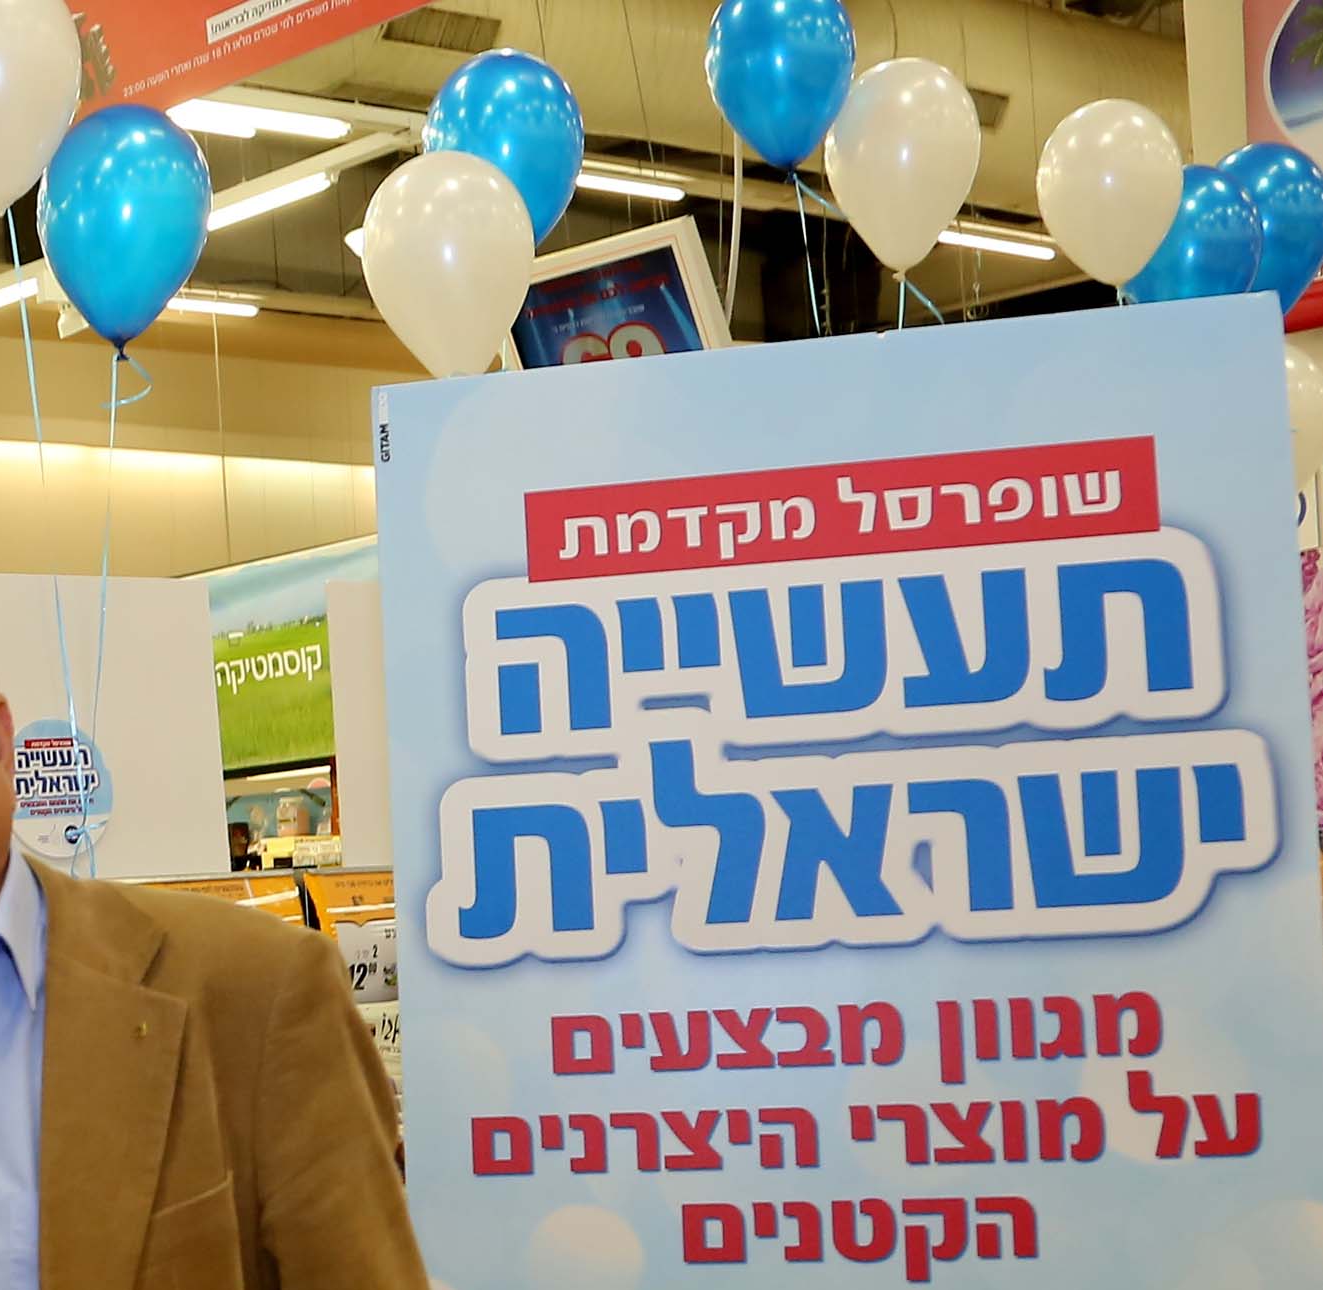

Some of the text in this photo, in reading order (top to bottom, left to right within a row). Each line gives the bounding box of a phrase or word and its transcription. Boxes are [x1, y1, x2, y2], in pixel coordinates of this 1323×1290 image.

[379, 424, 390, 462] GITAM
[558, 466, 1123, 561] שופרסל מקדמת
[215, 643, 322, 694] קוסמטיקה
[494, 557, 1196, 736] תעשייה
[458, 738, 1247, 940] ישראלית
[551, 990, 1164, 1084] מגוון מבצעים
[471, 1070, 1262, 1177] על מוצרי היצרנים
[681, 1194, 1038, 1282] הקטנים
